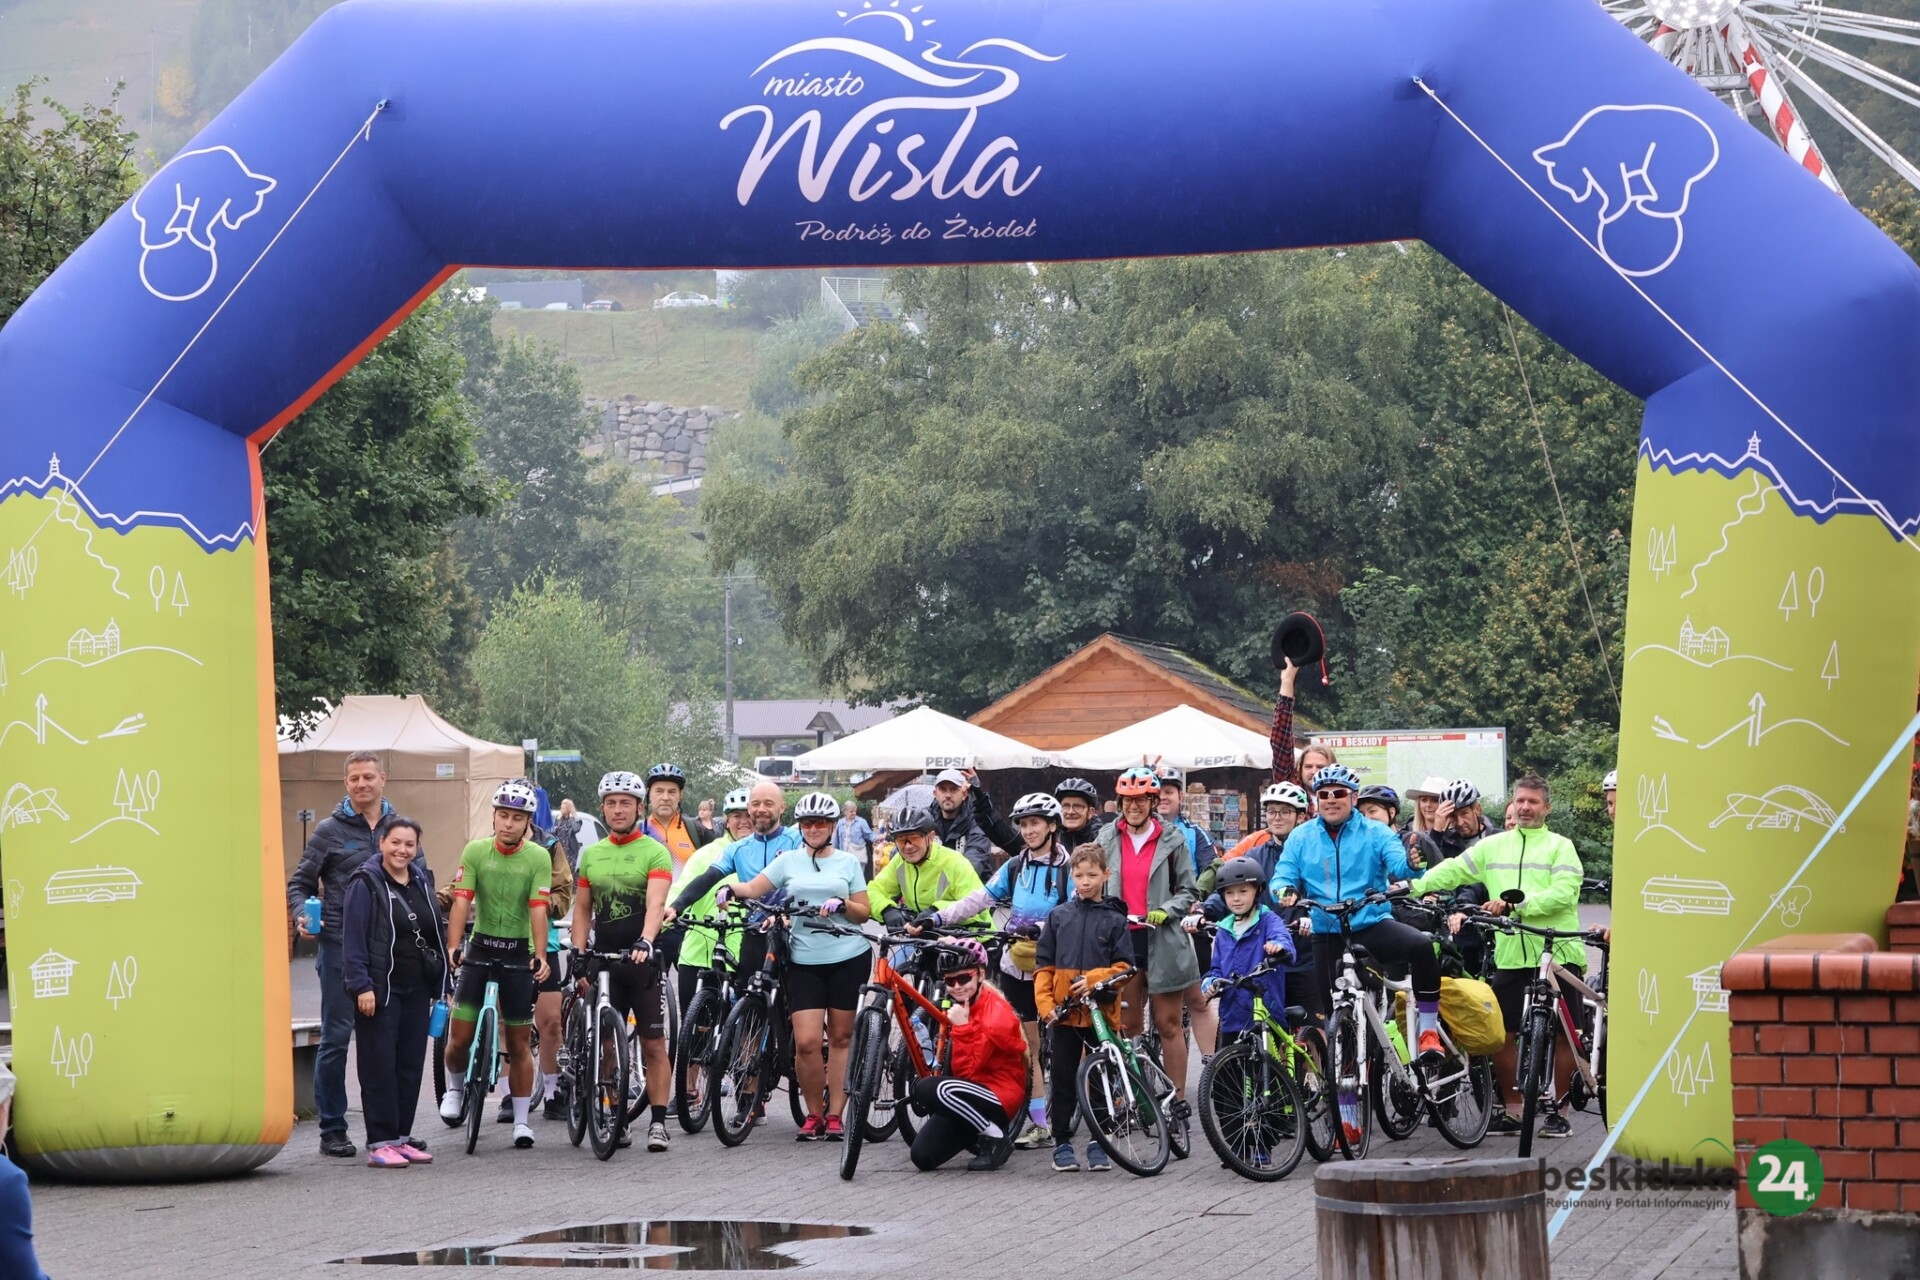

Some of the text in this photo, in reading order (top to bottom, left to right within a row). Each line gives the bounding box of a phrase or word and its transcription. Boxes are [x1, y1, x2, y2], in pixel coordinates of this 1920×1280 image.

[763, 70, 865, 97] miasto
[795, 220, 896, 246] Podróż
[901, 221, 932, 240] do
[1323, 737, 1343, 748] MTB
[1346, 736, 1383, 747] BESKIDY
[925, 756, 966, 767] PEPSI
[1194, 755, 1237, 766] PEPSI
